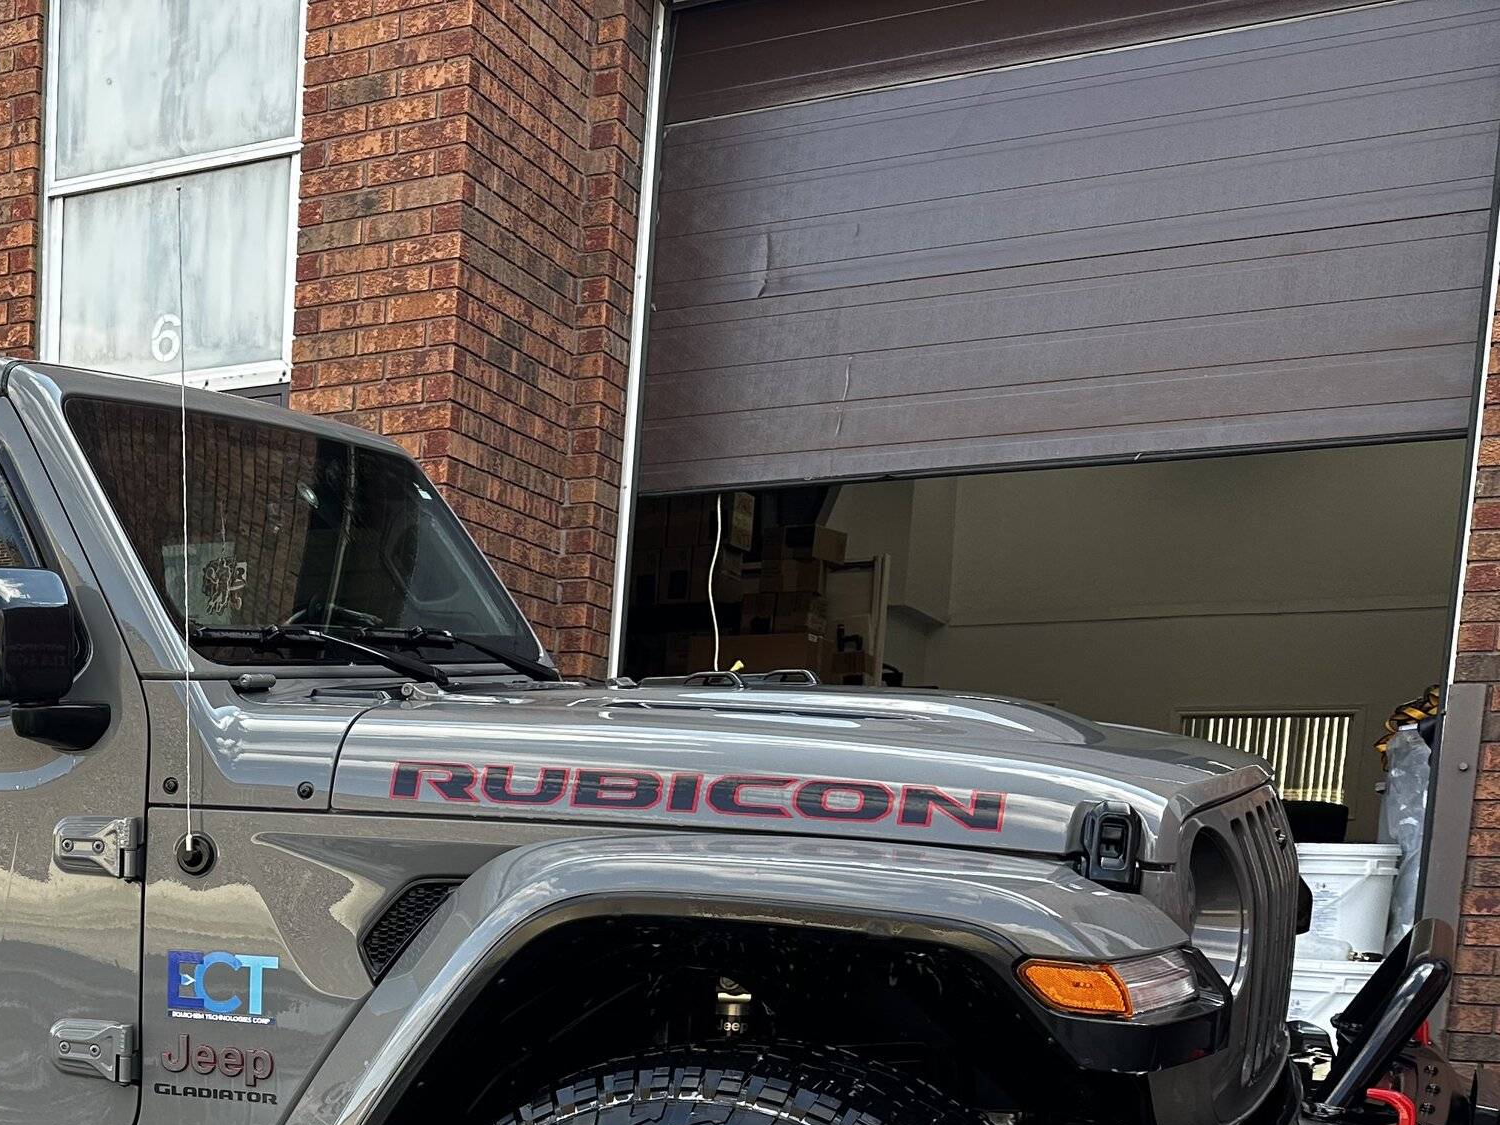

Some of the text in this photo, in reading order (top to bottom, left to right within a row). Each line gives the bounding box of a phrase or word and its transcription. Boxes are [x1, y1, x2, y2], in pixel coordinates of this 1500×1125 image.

[151, 313, 181, 362] 6
[389, 760, 1008, 833] RUBICON
[167, 951, 279, 1016] ECT
[205, 1013, 252, 1023] TECHNOLOGIES
[716, 1018, 749, 1035] Jeep
[161, 1033, 275, 1088] Jeep
[153, 1083, 279, 1105] GLADIATOR
